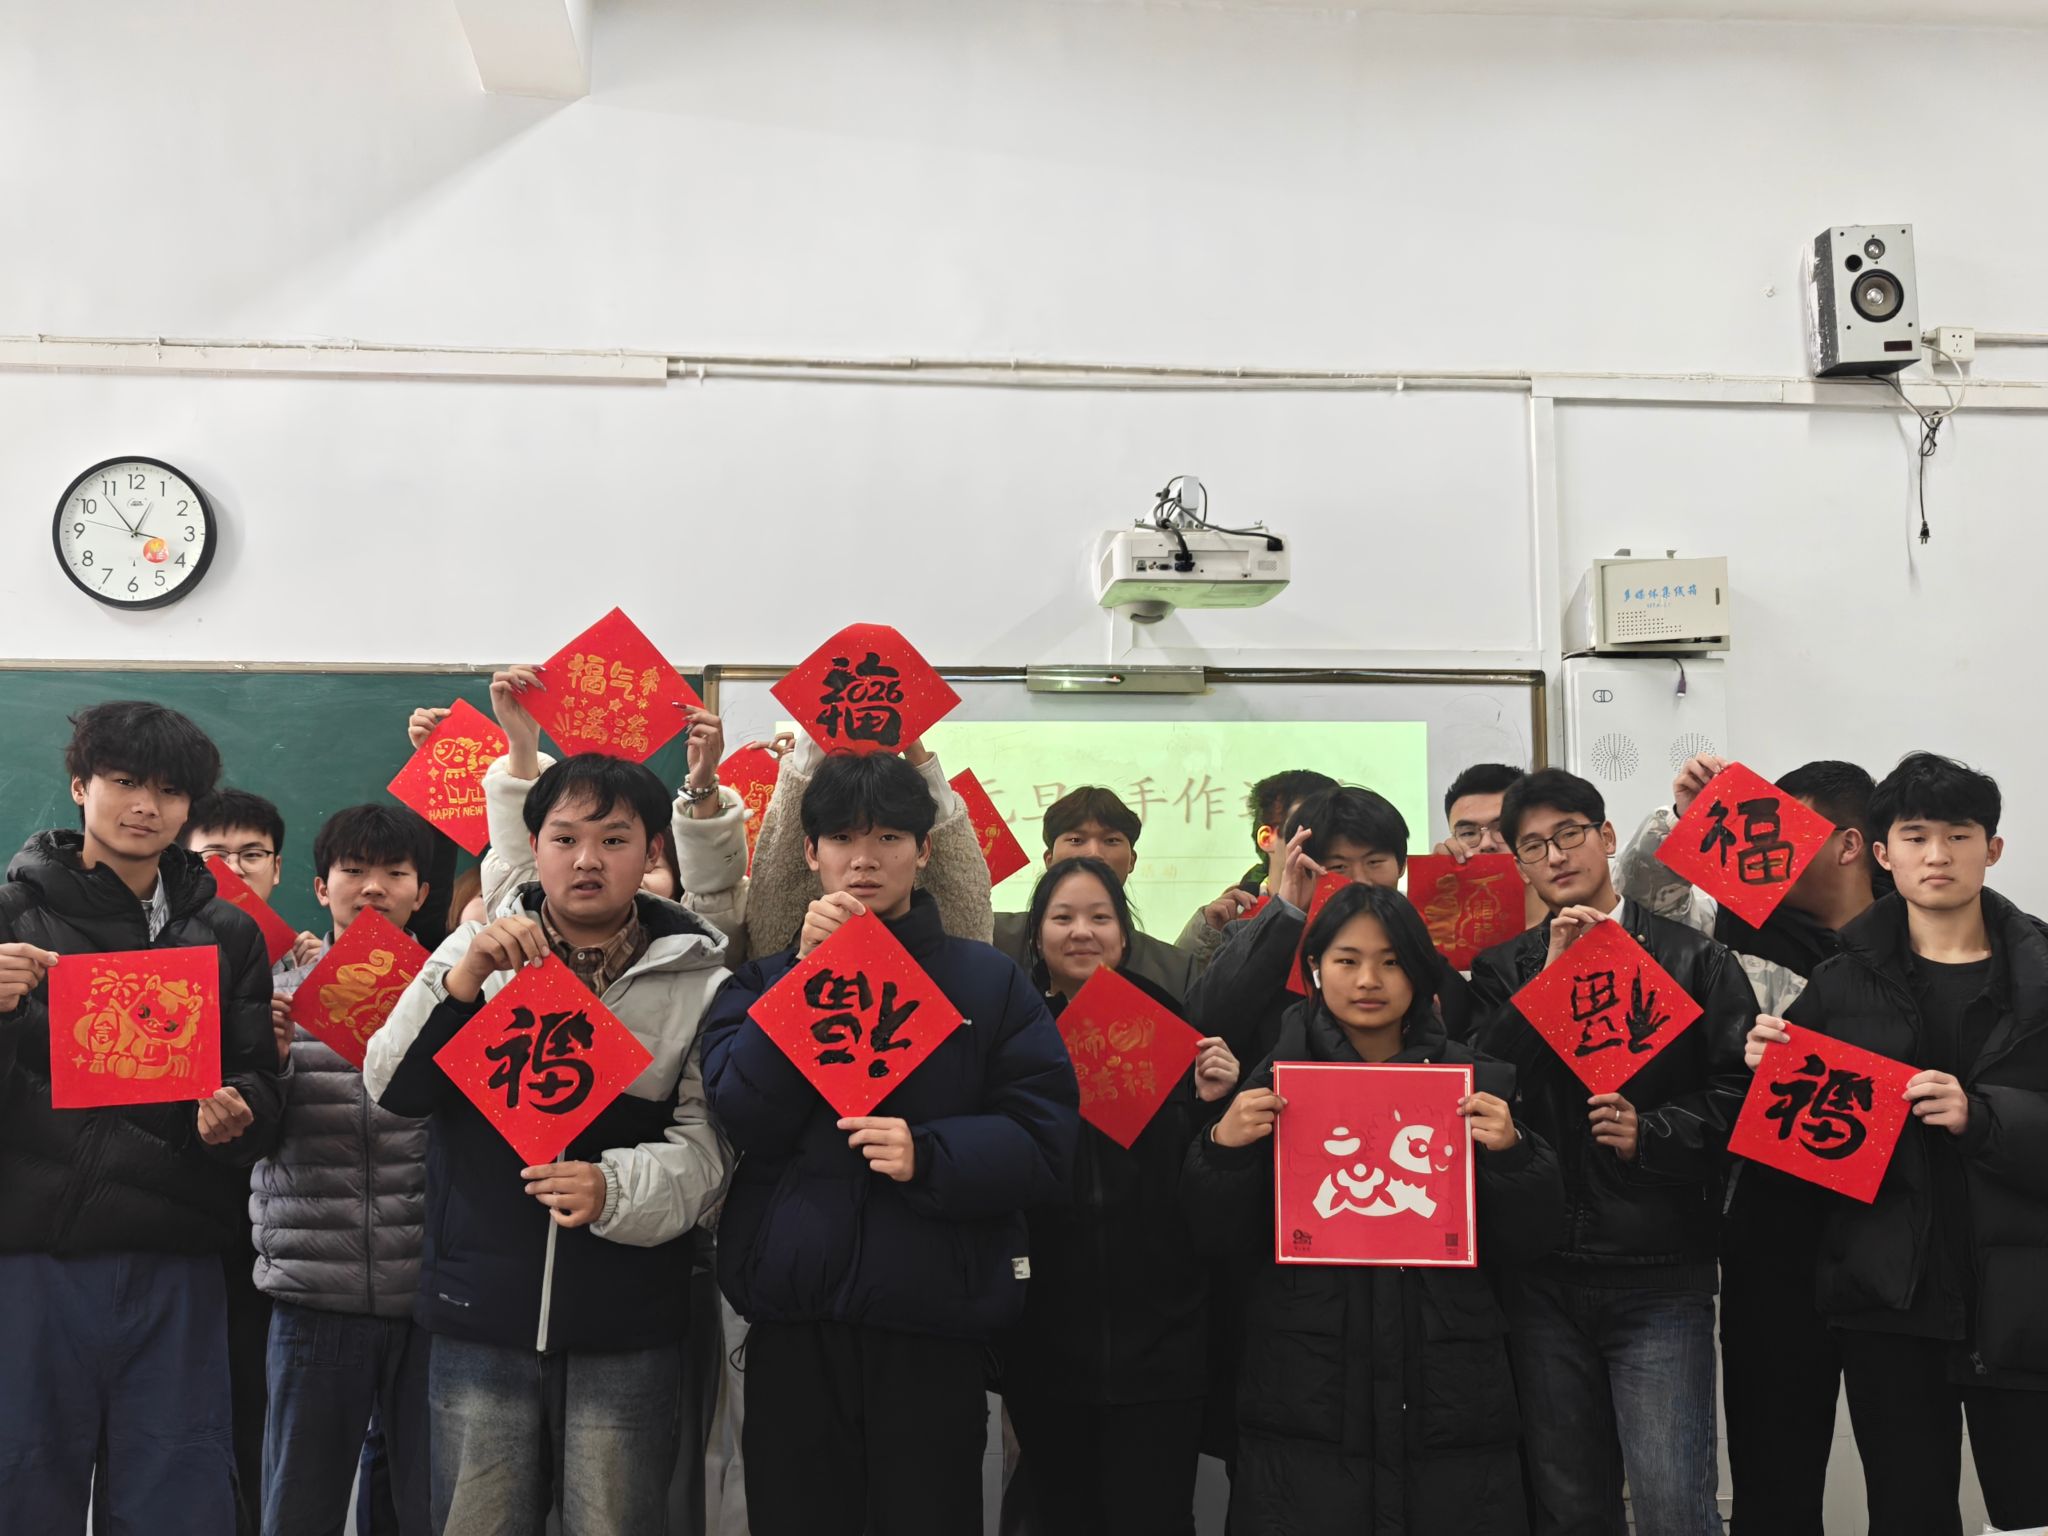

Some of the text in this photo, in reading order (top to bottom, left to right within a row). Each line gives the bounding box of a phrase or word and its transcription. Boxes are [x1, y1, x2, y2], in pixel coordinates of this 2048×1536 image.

[102, 480, 165, 497] 11 1
[127, 474, 146, 490] 12
[80, 498, 188, 516] 10 2
[73, 522, 195, 542] 9 3
[81, 550, 94, 567] 8
[174, 552, 186, 568] 4
[101, 568, 166, 586] 7 5
[127, 576, 139, 592] 6
[1624, 584, 1697, 602] 多媒体集线箱
[567, 653, 637, 701] 福气
[572, 706, 649, 753] 满满
[428, 806, 461, 821] HAPPY
[462, 805, 484, 817] NEW
[1699, 797, 1794, 885] 福
[484, 1005, 595, 1115] 福
[1765, 1054, 1875, 1160] 福
